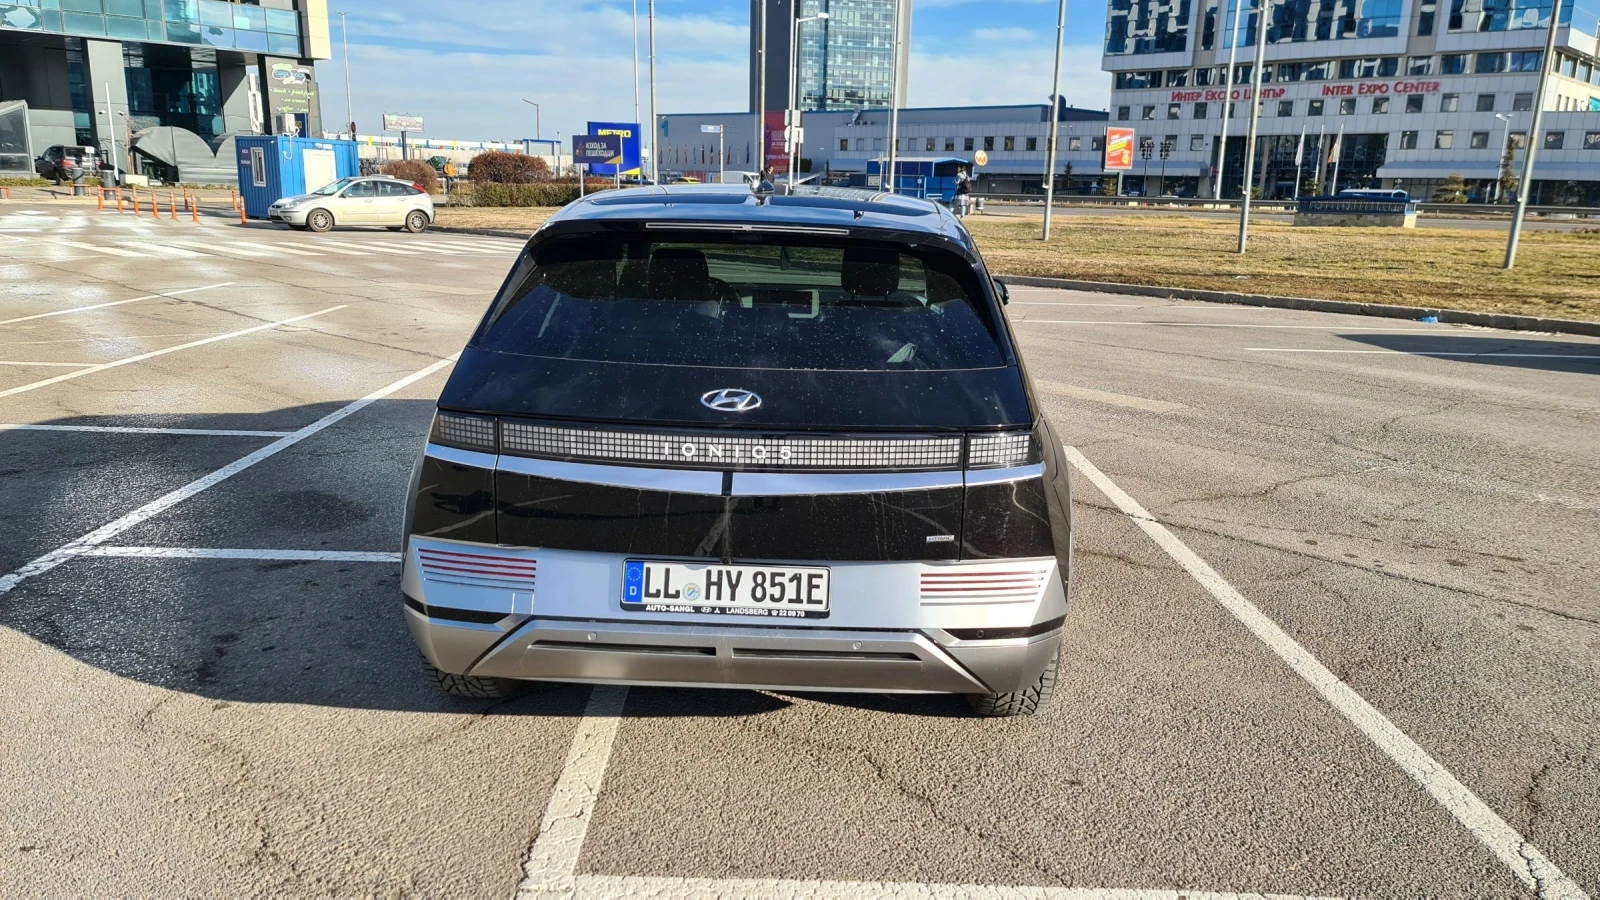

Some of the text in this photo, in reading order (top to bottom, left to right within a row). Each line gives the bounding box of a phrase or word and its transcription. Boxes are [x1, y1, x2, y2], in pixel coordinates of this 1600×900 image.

[1171, 88, 1286, 102] ИНТЕР ЕКСО ЦНТЪР
[1322, 81, 1441, 96] INTER EXPO CENTER
[661, 119, 669, 137] 1
[629, 585, 637, 596] D
[643, 566, 824, 605] LL HY 851E
[645, 604, 696, 613] AUTO-SANGL
[725, 607, 769, 616] LANDSBERG
